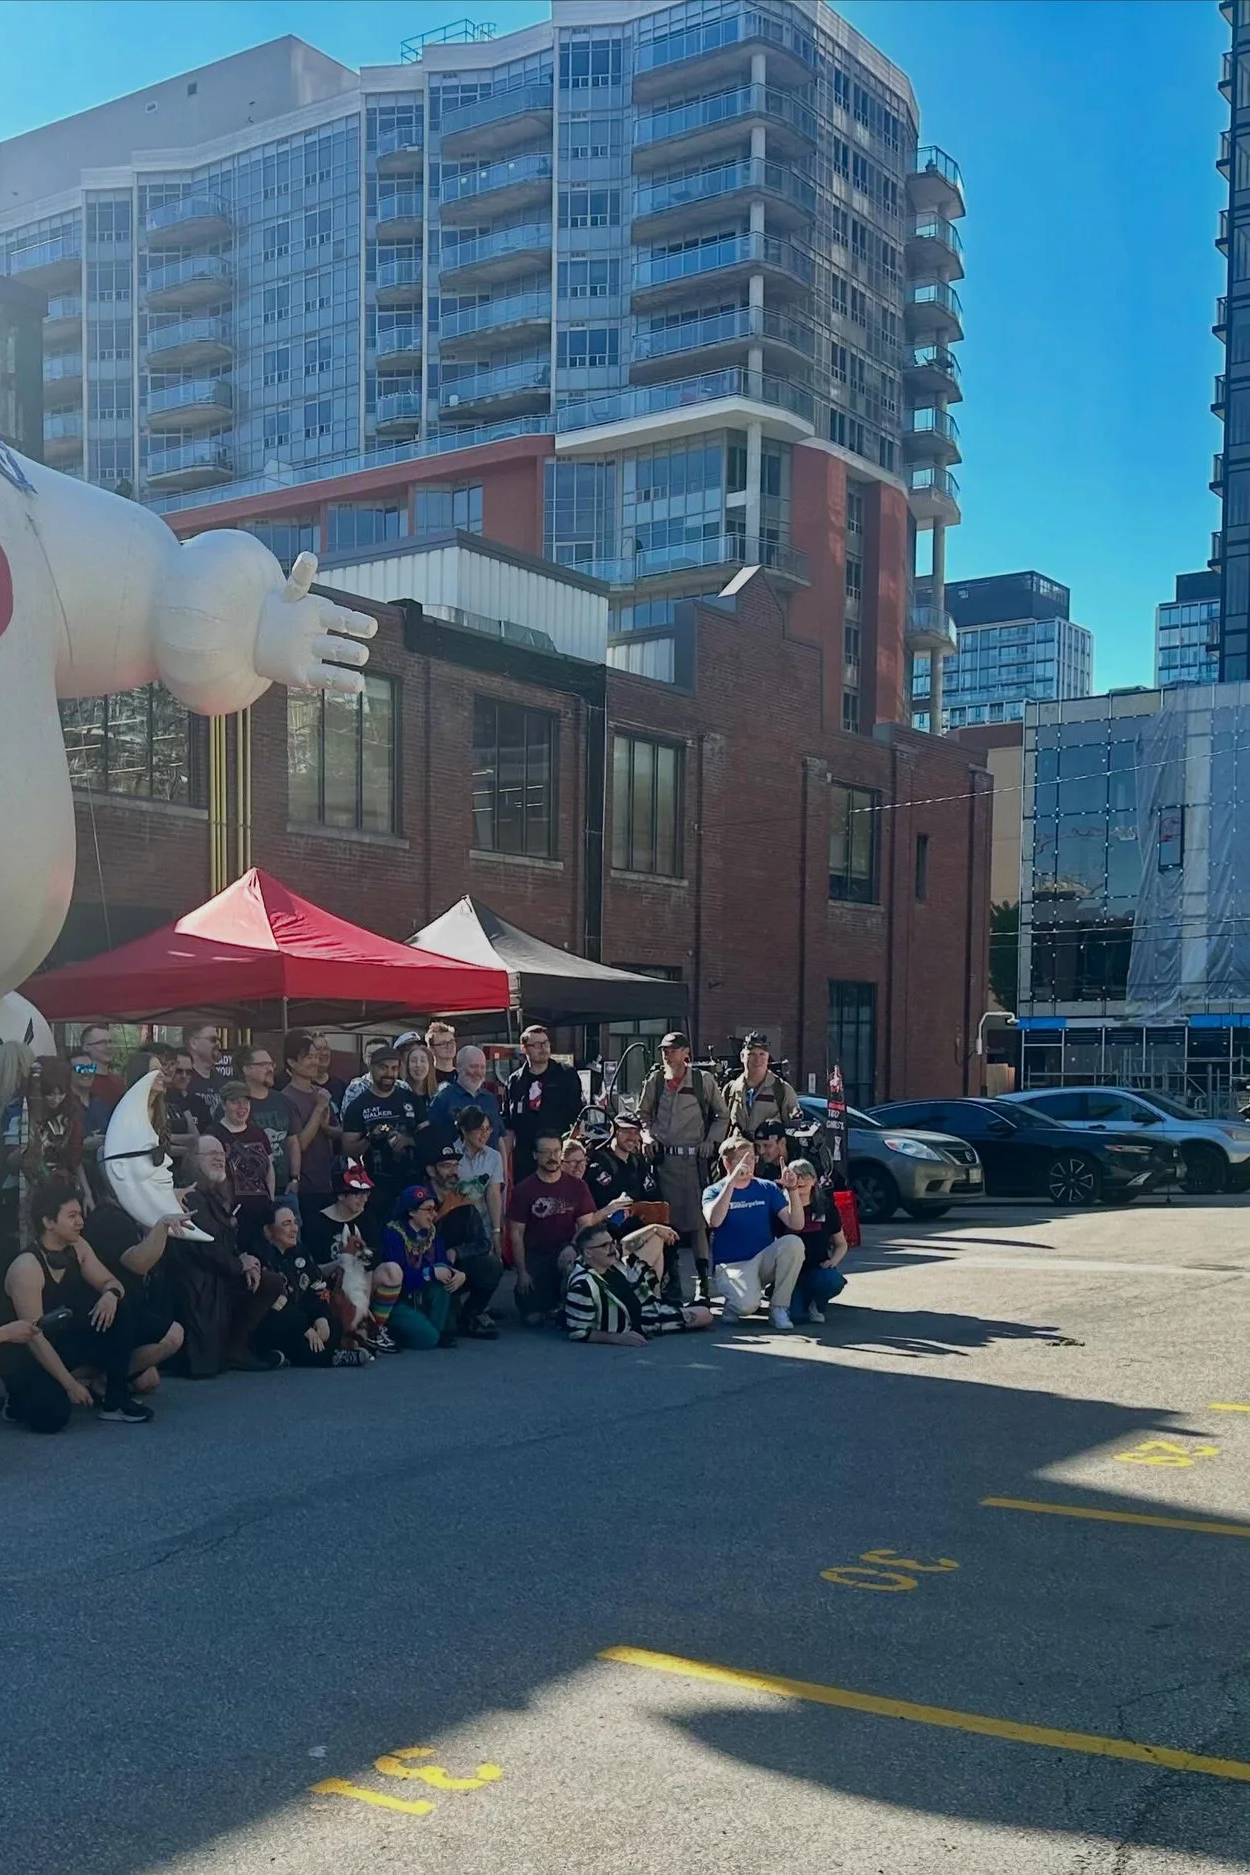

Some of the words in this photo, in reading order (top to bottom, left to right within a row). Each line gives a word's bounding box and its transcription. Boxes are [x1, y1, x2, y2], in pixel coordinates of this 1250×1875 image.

[362, 1110, 392, 1119] WALKER
[820, 1549, 960, 1591] 30
[308, 1747, 502, 1816] 31
